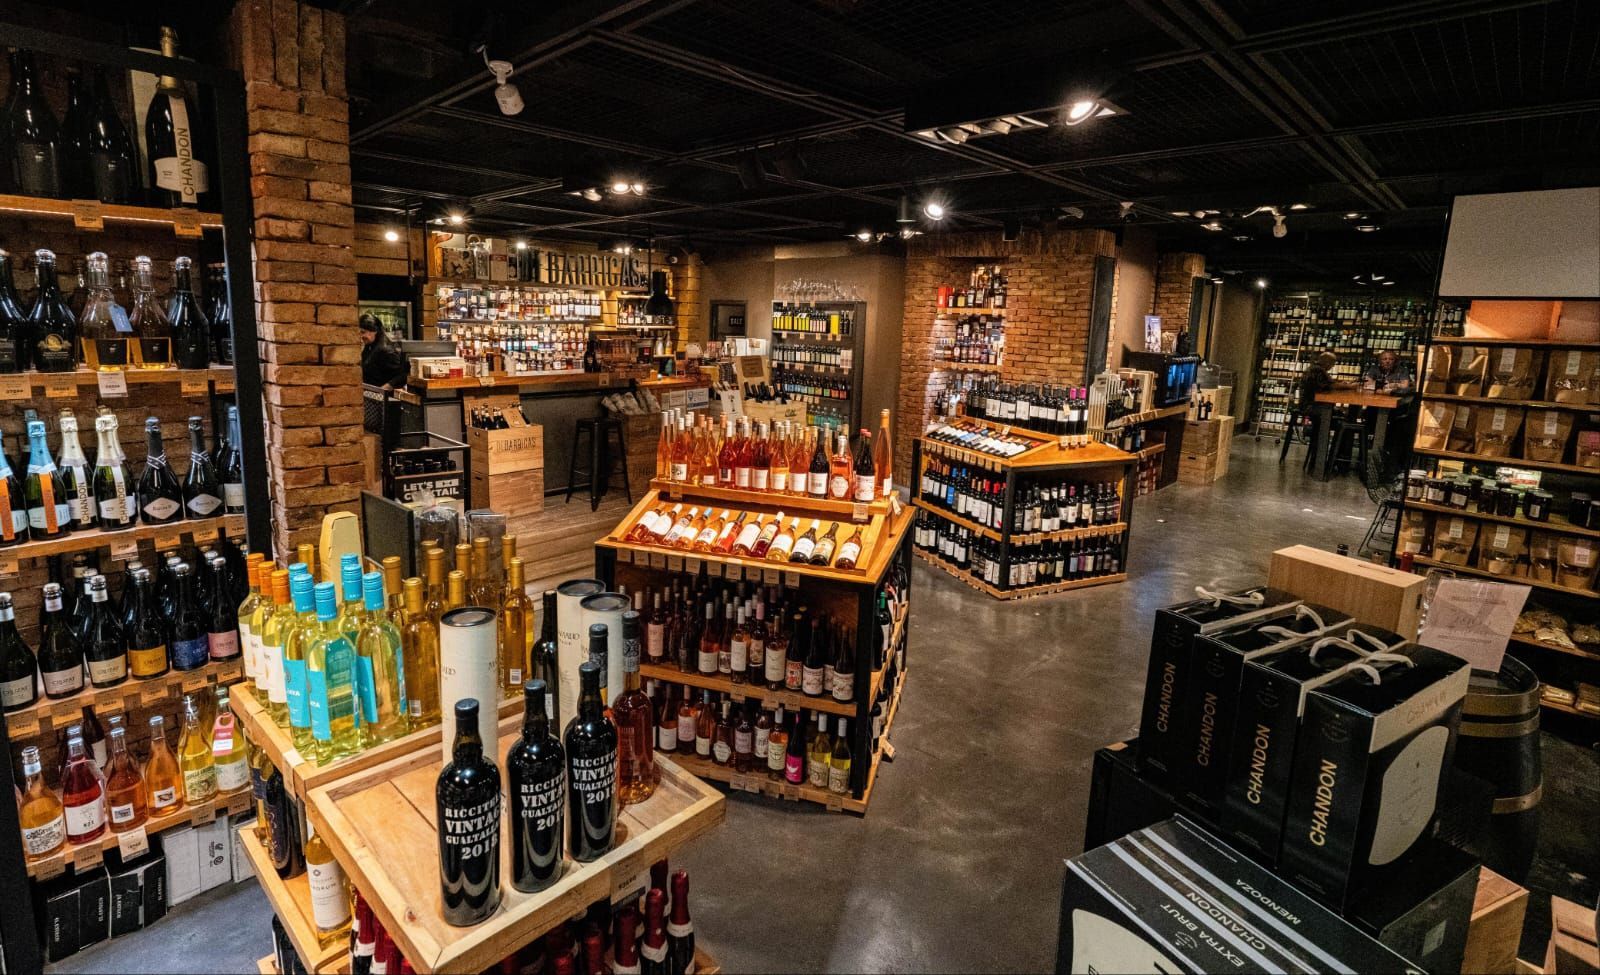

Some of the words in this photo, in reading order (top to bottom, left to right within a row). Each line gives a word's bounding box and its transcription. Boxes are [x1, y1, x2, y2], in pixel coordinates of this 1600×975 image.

[176, 127, 195, 196] CHANDON
[78, 481, 90, 521] CHANDON
[116, 481, 128, 521] CHANDON
[403, 480, 434, 493] LET'S
[403, 487, 460, 501] CTAIL
[1156, 662, 1177, 733] CHANDON
[1197, 691, 1218, 767] CHANDON
[1246, 724, 1271, 804] CHANDON
[1309, 759, 1338, 847] CHANDON
[461, 833, 499, 860] 2018
[1159, 904, 1199, 932] BRUT
[1186, 891, 1266, 950] CHANDON
[1235, 878, 1302, 926] MENDOZA
[1198, 930, 1246, 967] EXTRA
